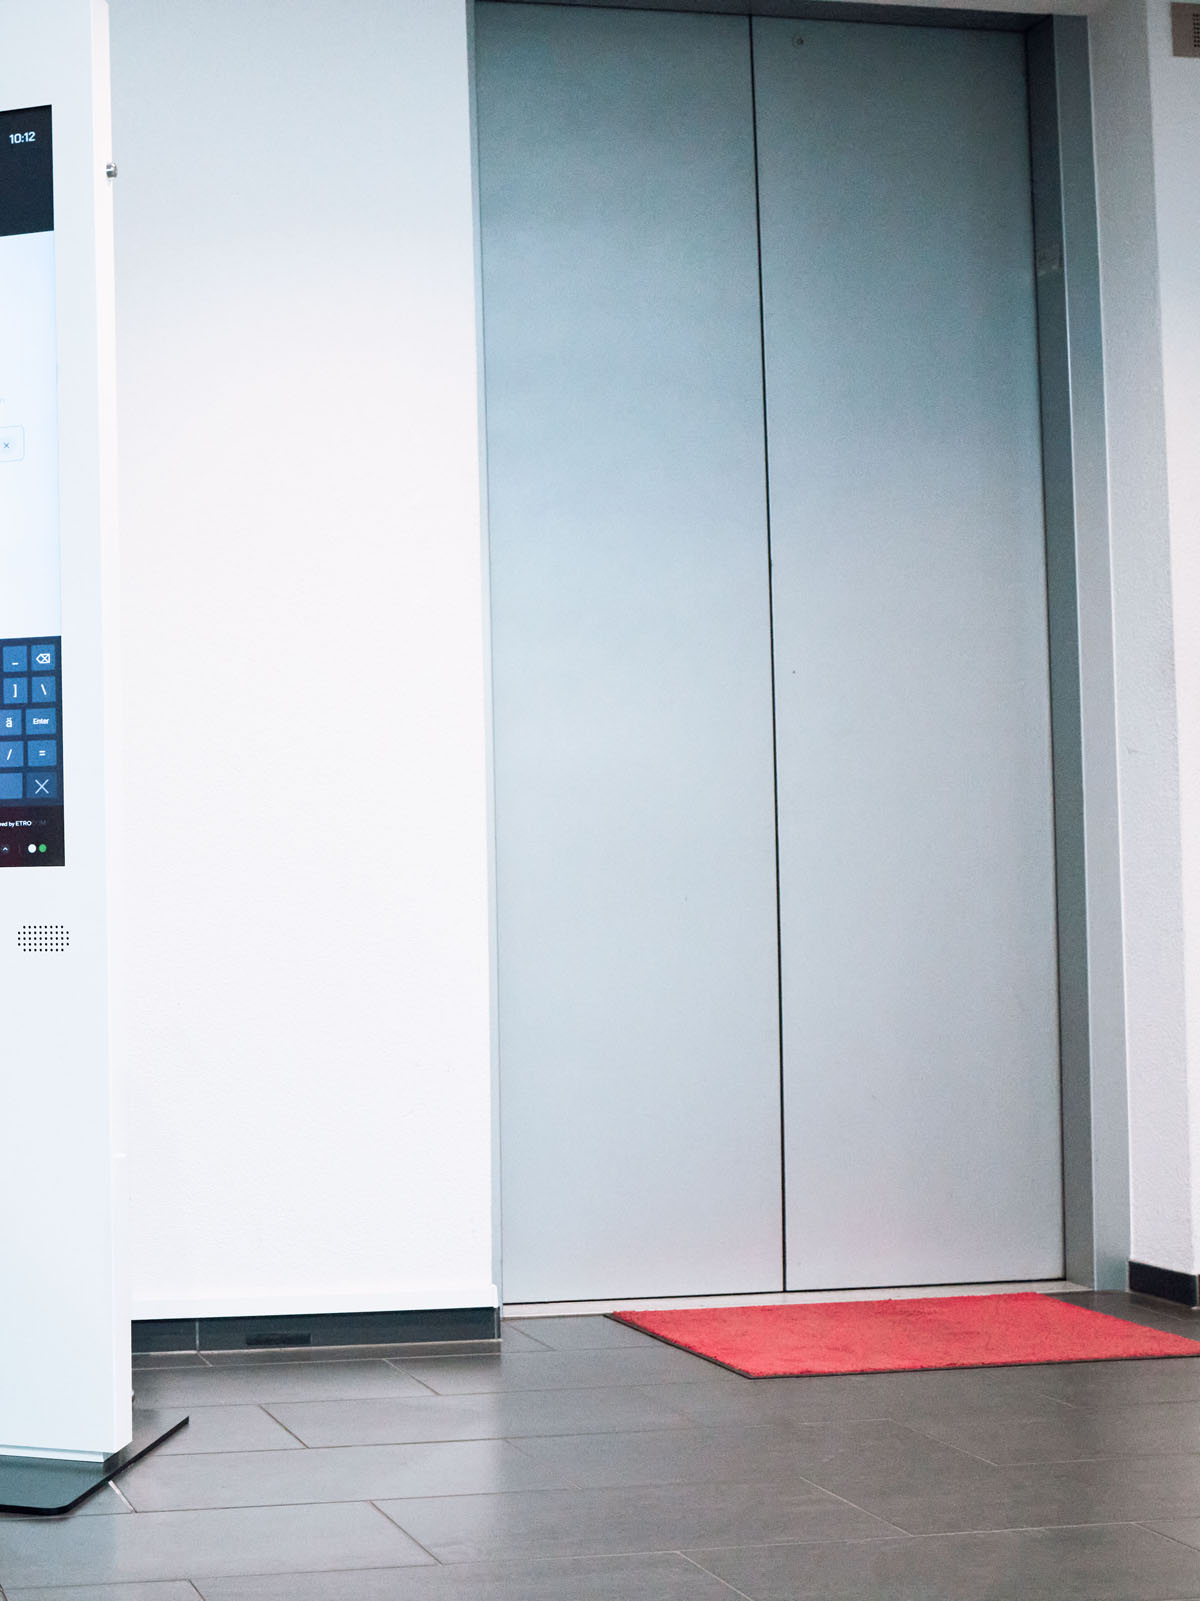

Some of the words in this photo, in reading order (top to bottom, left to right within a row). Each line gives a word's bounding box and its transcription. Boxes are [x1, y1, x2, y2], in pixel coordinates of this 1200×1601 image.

[9, 131, 36, 145] 10:12
[5, 717, 13, 728] ä
[32, 717, 49, 726] Enter
